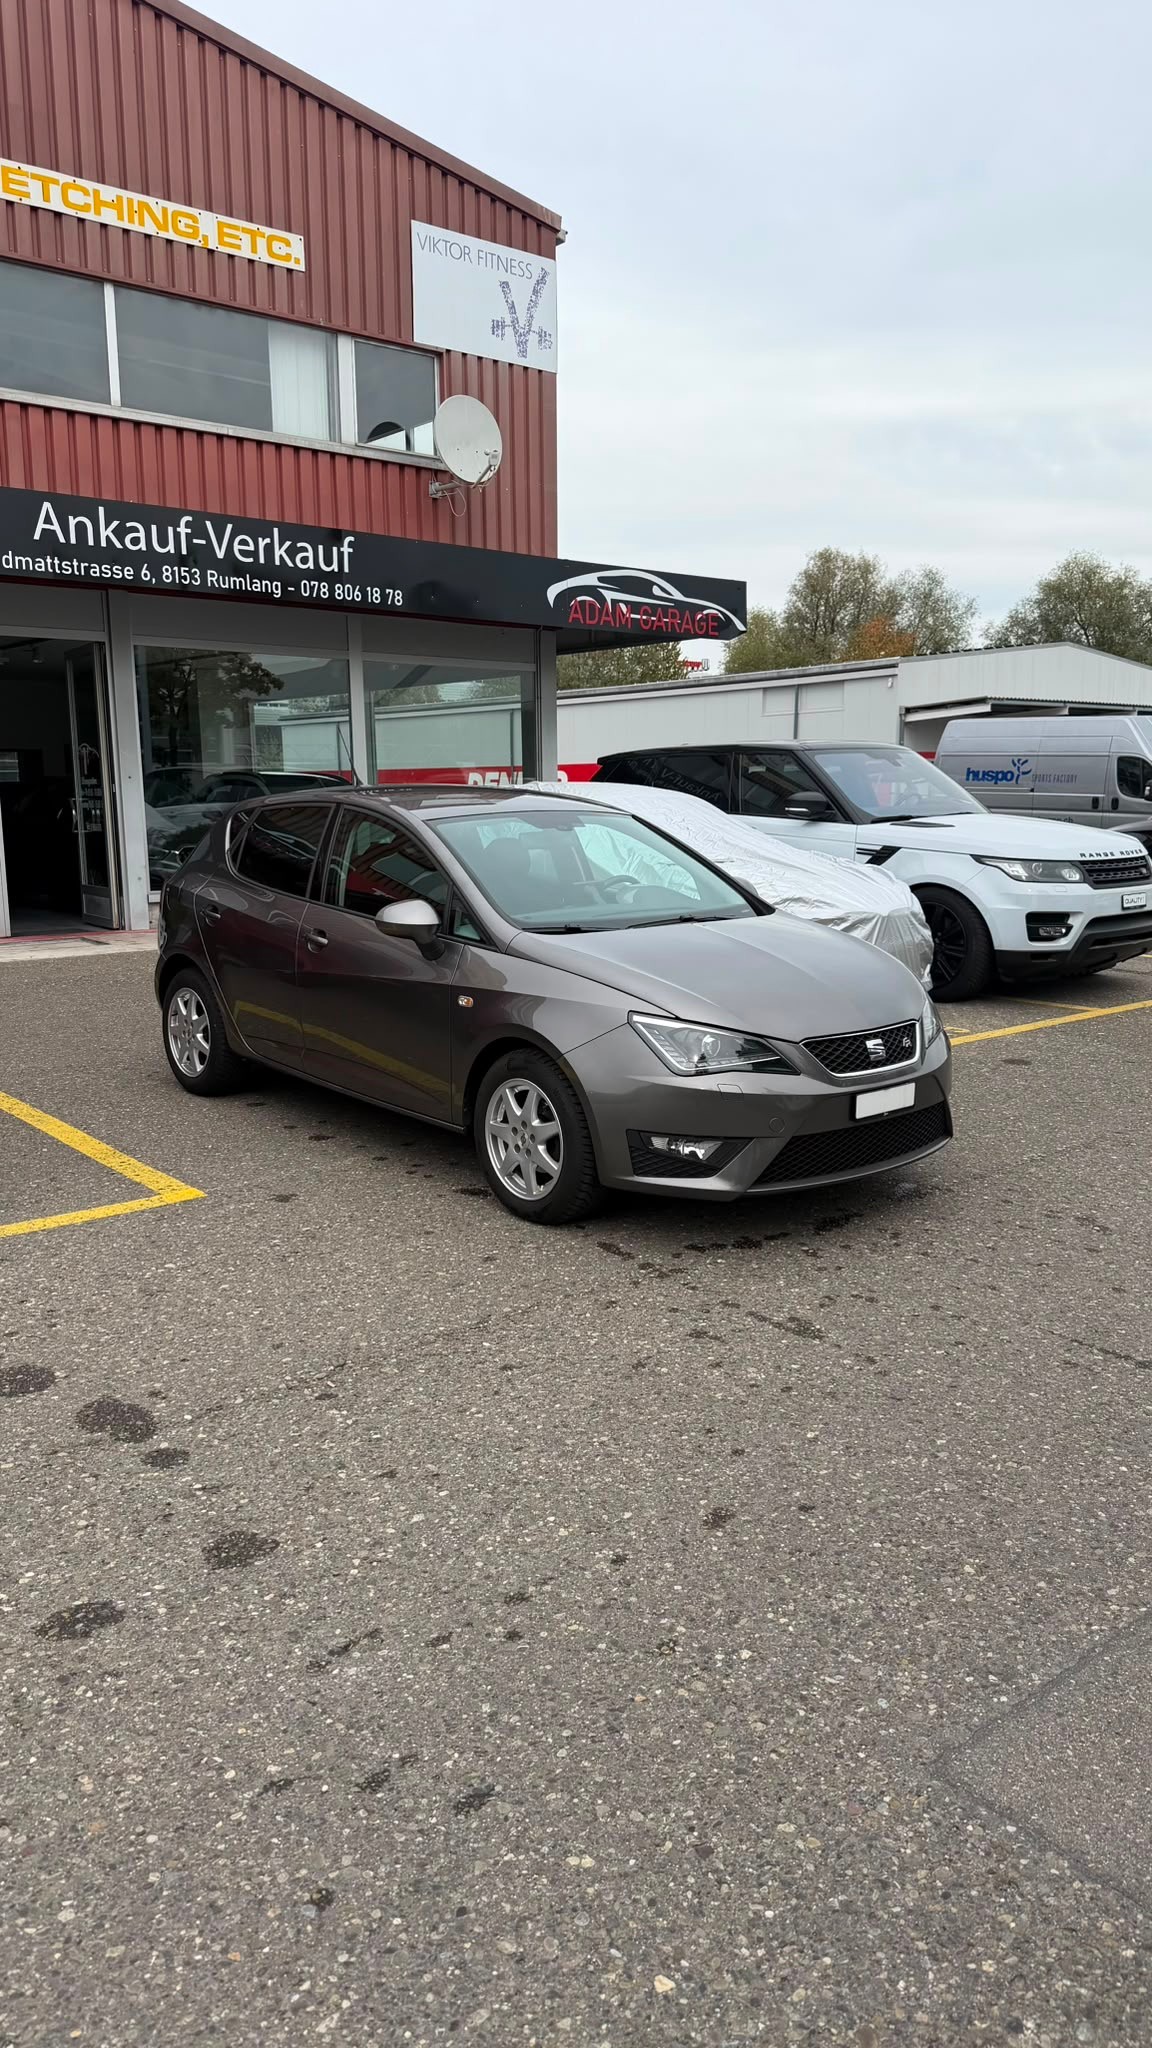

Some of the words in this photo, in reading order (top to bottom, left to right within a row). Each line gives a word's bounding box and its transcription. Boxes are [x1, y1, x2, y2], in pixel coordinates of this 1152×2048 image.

[216, 220, 300, 265] ETC.
[417, 232, 473, 264] VIKTOR
[477, 250, 533, 280] FITNESS
[33, 501, 355, 572] Ankauf-Verkauf
[140, 564, 156, 585] 6,
[162, 565, 201, 586] 8153
[207, 569, 281, 598] Rumlang
[300, 581, 329, 599] 078
[334, 583, 362, 601] 806
[366, 586, 381, 604] 18
[386, 588, 403, 606] 78
[568, 599, 632, 629] ADAM
[639, 605, 720, 636] GARAGE
[965, 767, 1015, 785] huspo
[1053, 773, 1078, 784] FACTORY
[1119, 848, 1143, 856] ROVER
